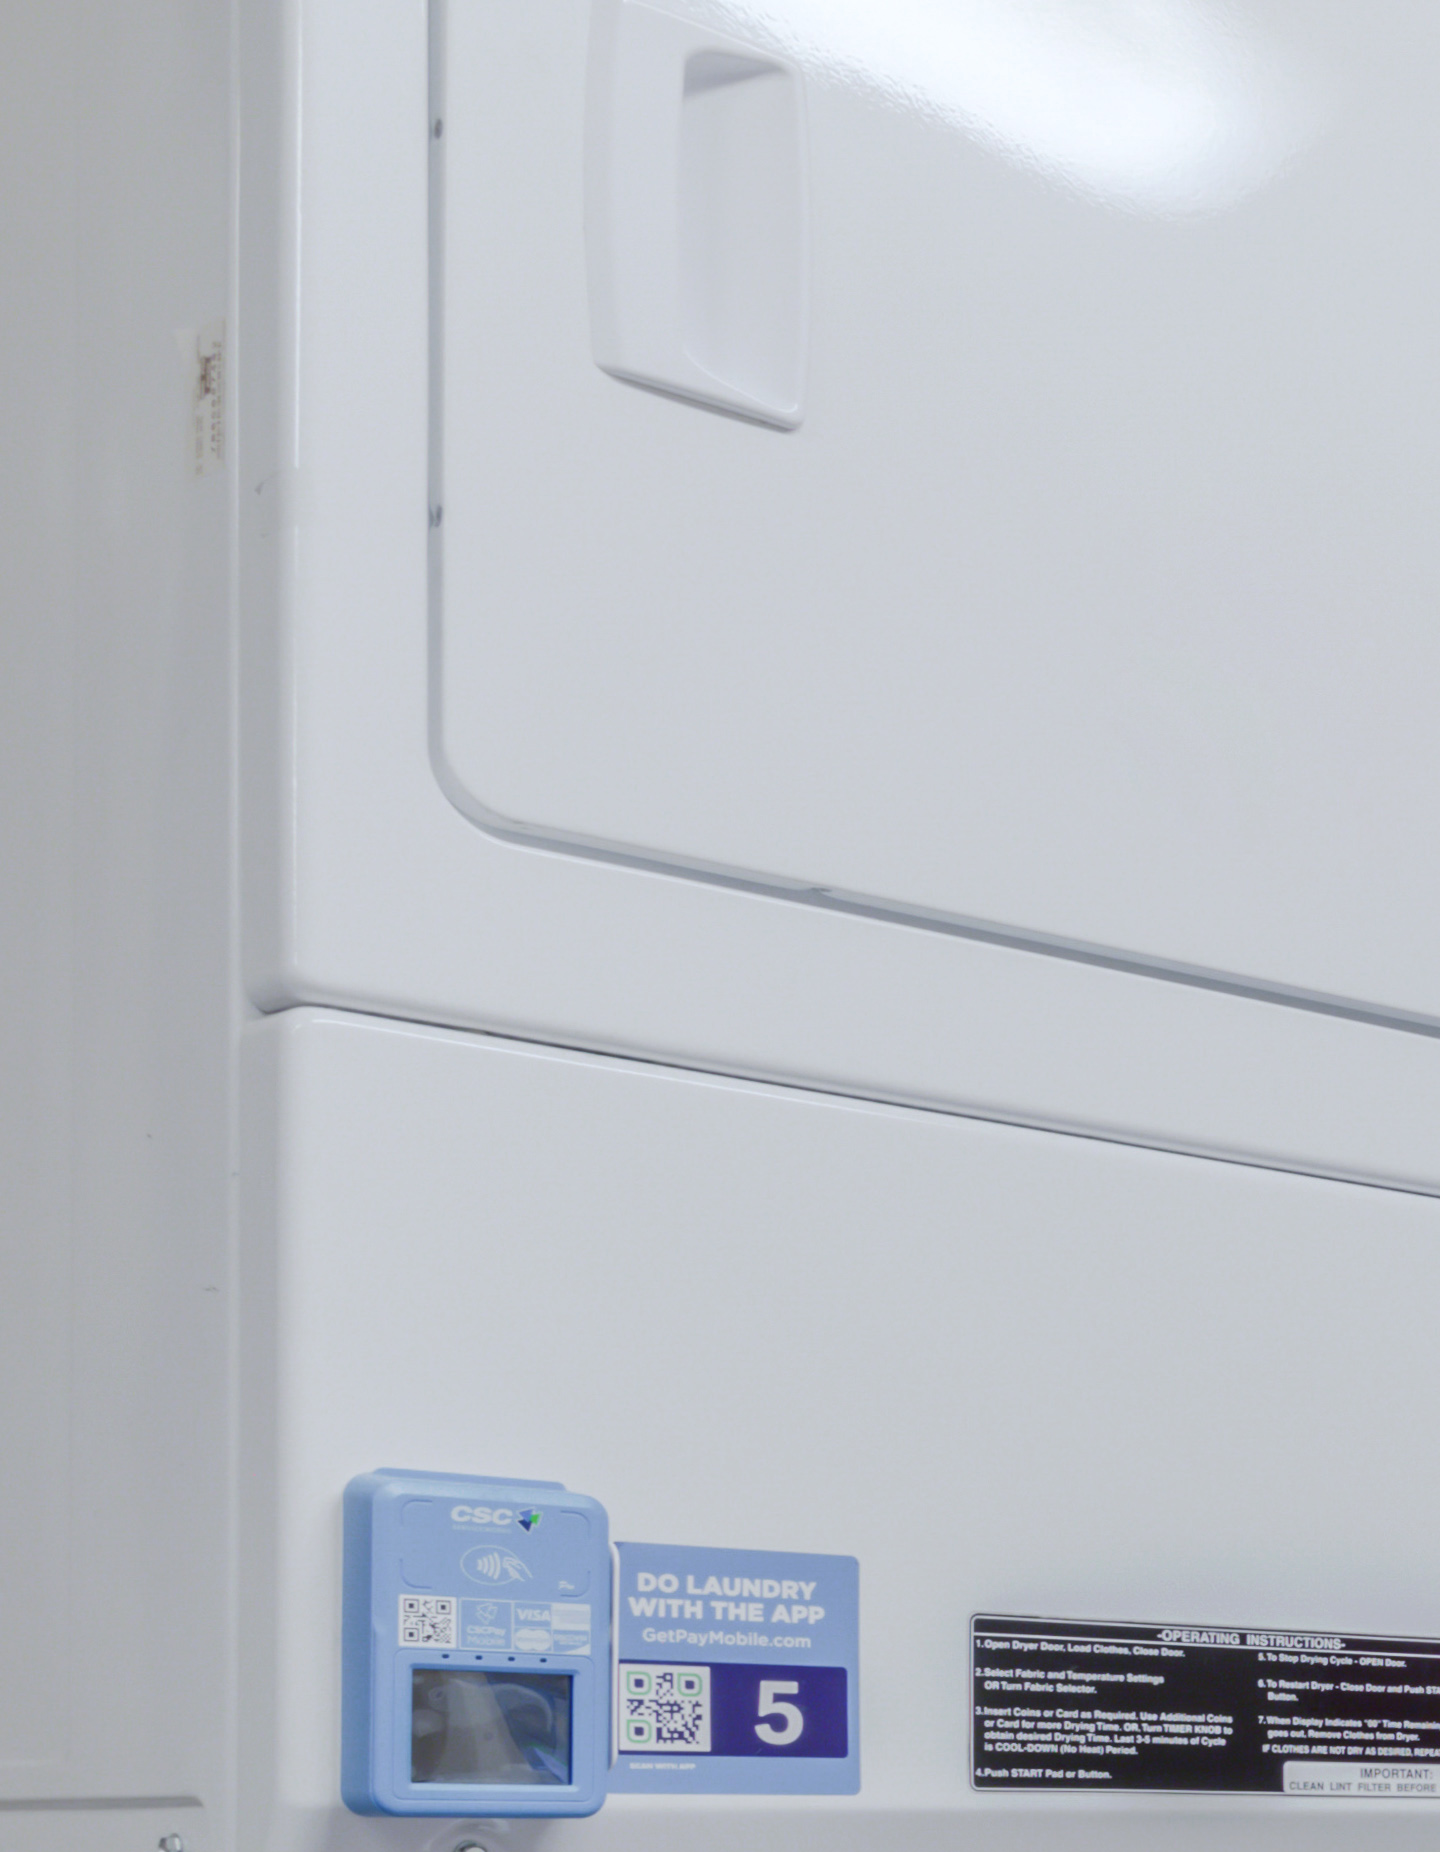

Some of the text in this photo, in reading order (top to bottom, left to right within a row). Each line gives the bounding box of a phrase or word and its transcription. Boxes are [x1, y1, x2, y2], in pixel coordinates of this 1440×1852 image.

[451, 1505, 513, 1525] CSC
[637, 1572, 816, 1600] DO LAUNDRY
[517, 1609, 550, 1621] VISA
[628, 1597, 825, 1623] WITH THE APP
[641, 1628, 811, 1647] GetPayMobile.com
[1011, 1639, 1039, 1651] Dryer
[1066, 1643, 1092, 1652] Load
[1132, 1645, 1160, 1655] Close
[1160, 1647, 1185, 1657] Door.
[1014, 1668, 1045, 1678] Fabric
[1046, 1670, 1066, 1679] and
[1065, 1670, 1125, 1681] Temperature
[1126, 1673, 1165, 1685] Settings
[983, 1680, 1097, 1693] OR Turn Fabric Selector.
[754, 1680, 804, 1746] 5
[1010, 1768, 1043, 1777] START
[1044, 1768, 1064, 1778] Pad
[1064, 1770, 1076, 1778] or
[1077, 1769, 1112, 1778] Button.
[1360, 1768, 1433, 1779] IMPORTANT:
[1288, 1780, 1324, 1790] CLEAN
[1329, 1781, 1352, 1791] LINT
[1357, 1782, 1391, 1791] FILTER
[1396, 1783, 1436, 1792] BEFORE
